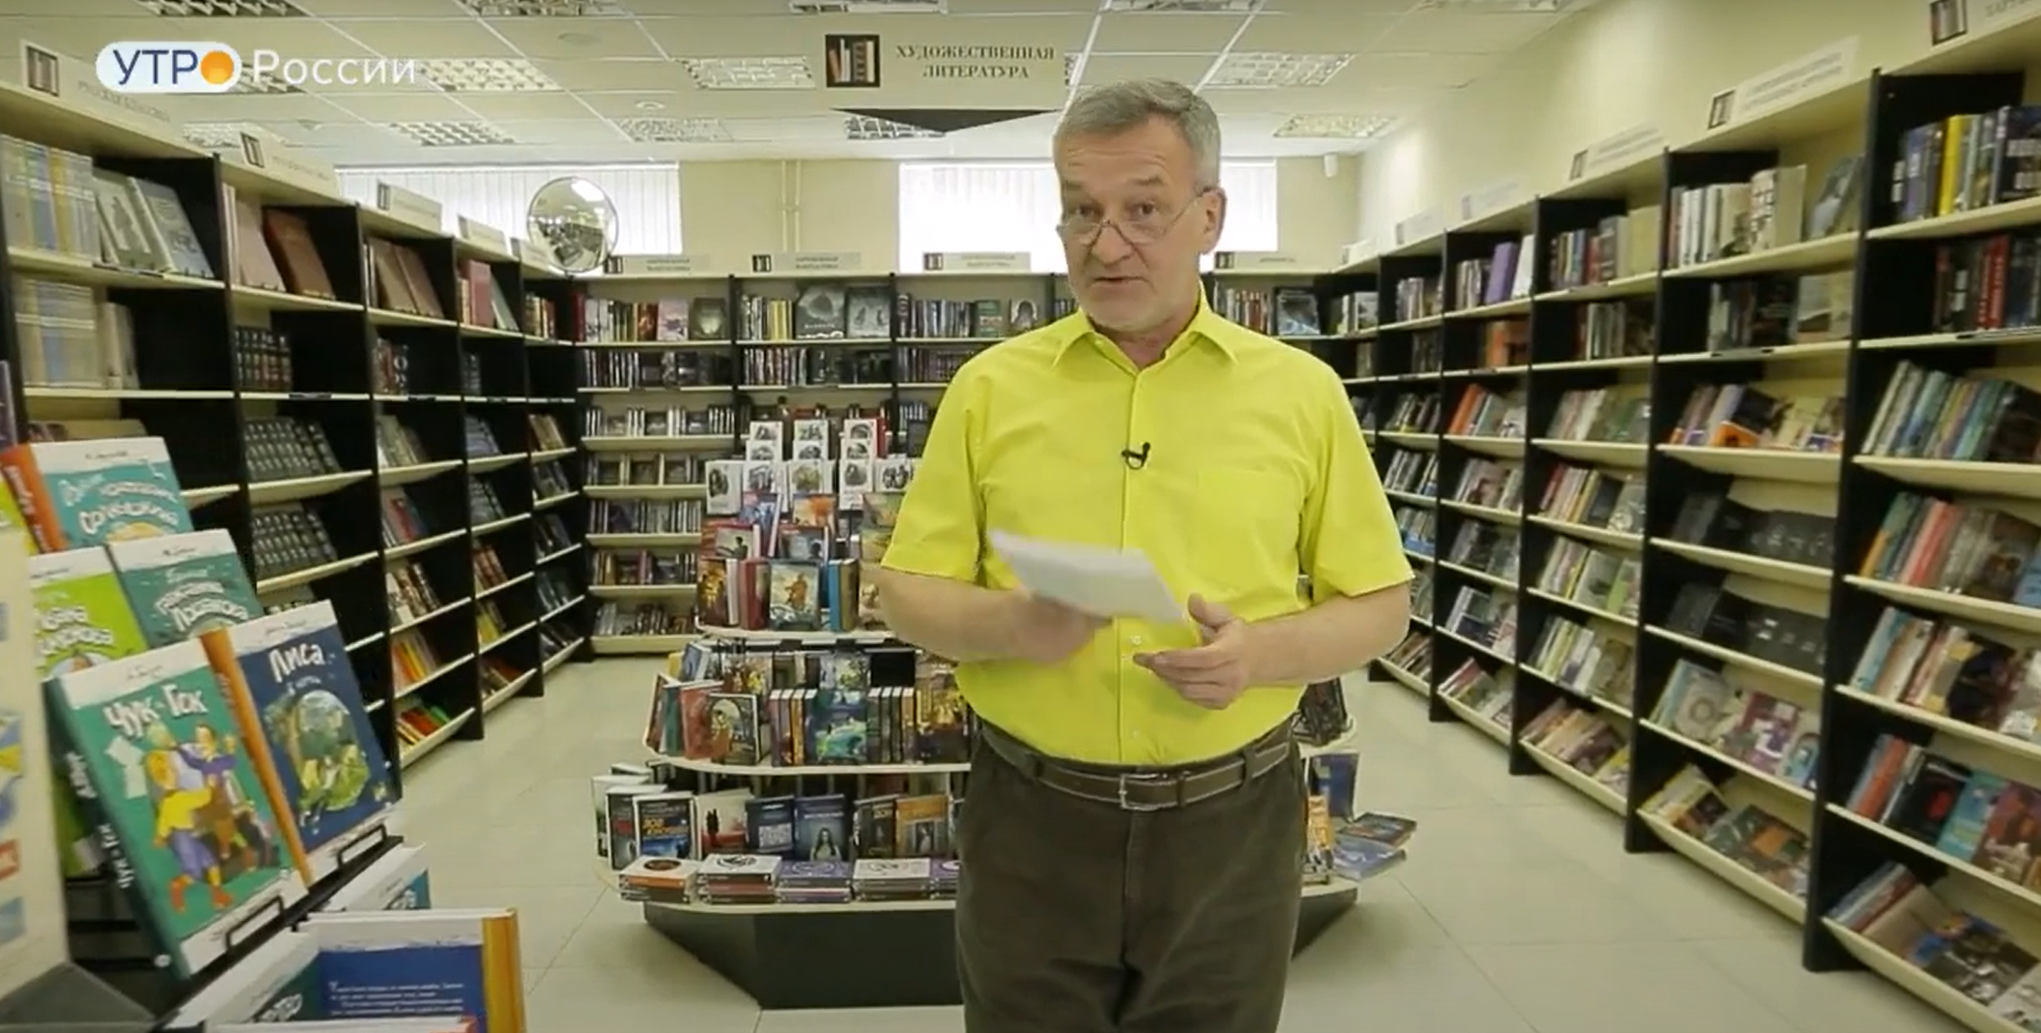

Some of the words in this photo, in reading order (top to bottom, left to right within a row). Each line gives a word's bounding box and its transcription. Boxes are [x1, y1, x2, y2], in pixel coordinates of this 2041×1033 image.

[896, 45, 1055, 60] ХУДОЖЕСТВЕННАЯ
[923, 64, 1030, 79] ЛИТЕРАТУРА
[268, 642, 326, 684] Лиса
